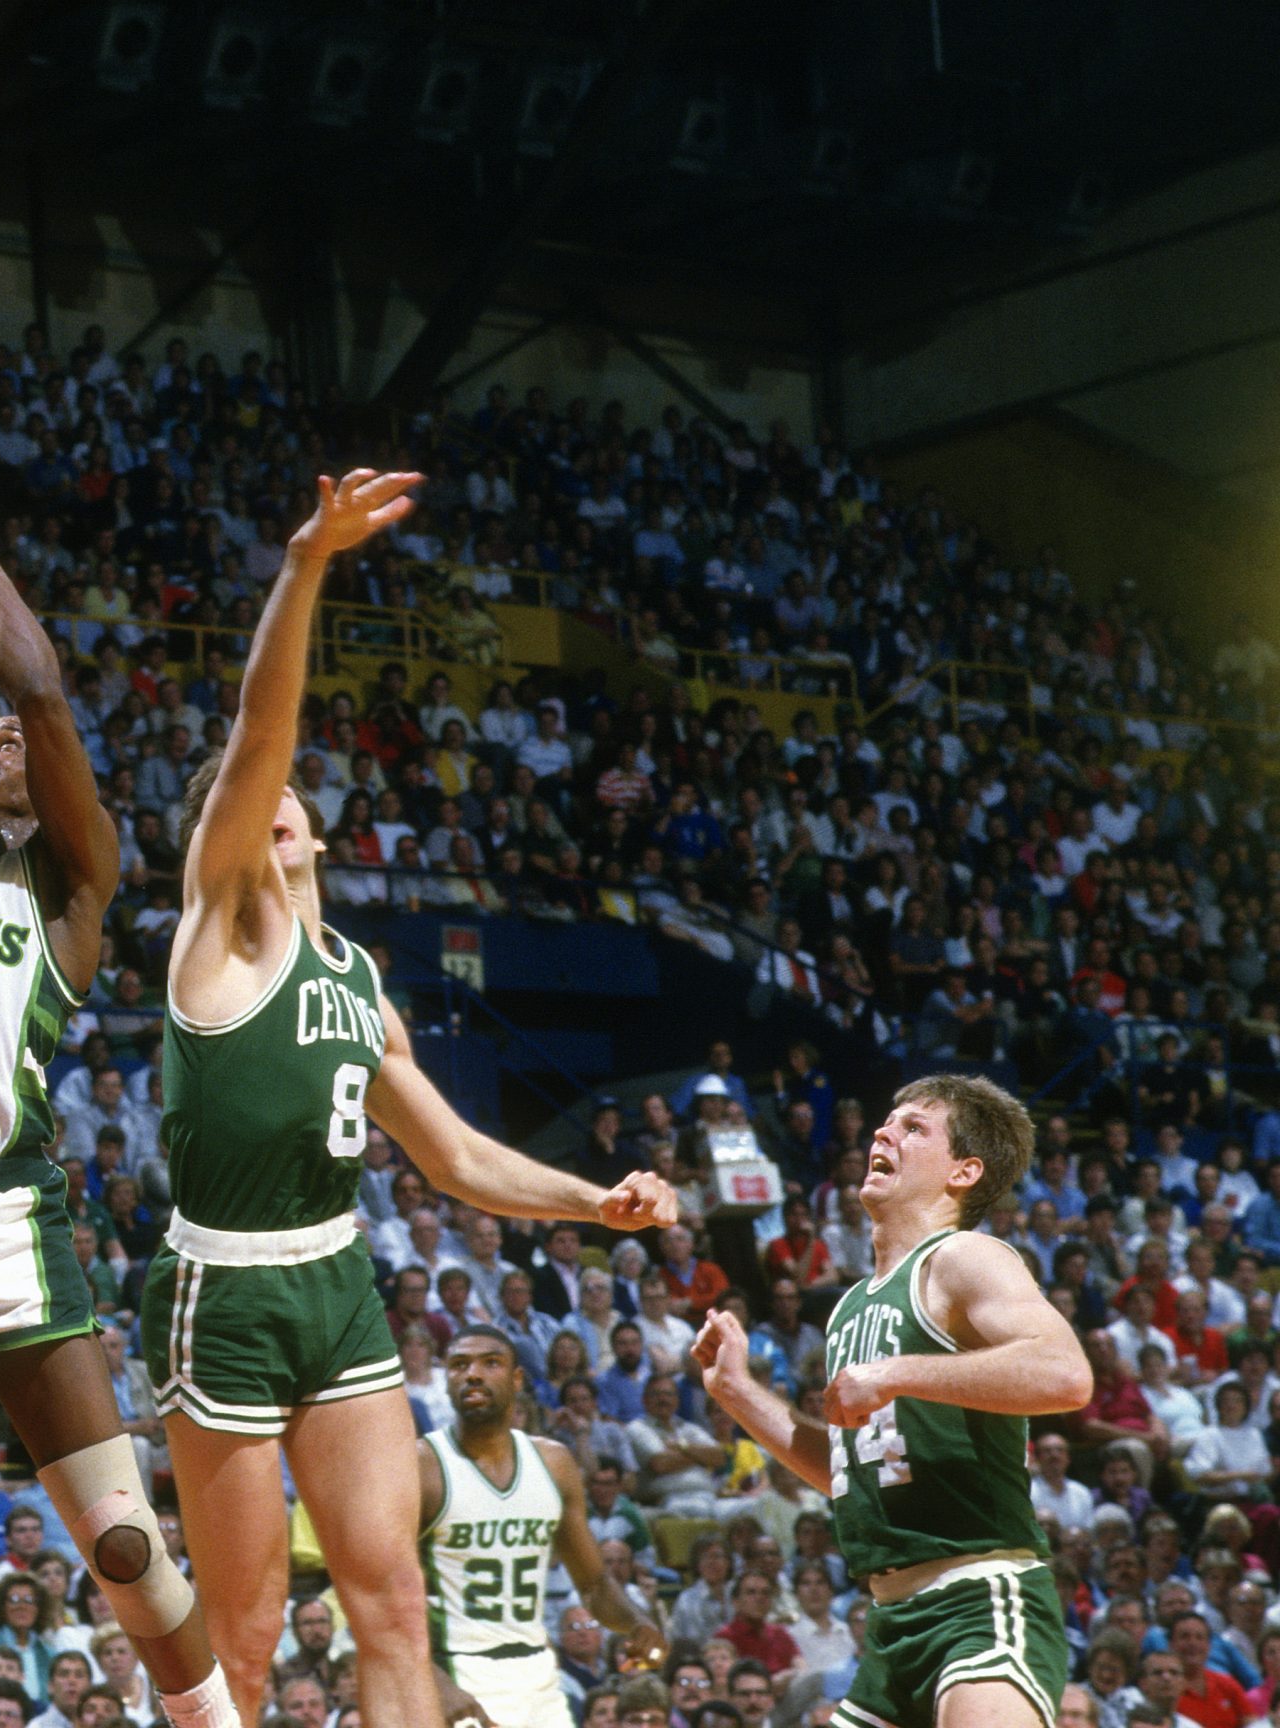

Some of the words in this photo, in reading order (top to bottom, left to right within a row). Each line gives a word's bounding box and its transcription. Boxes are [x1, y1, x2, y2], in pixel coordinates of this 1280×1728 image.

[327, 1063, 368, 1158] 8
[444, 1518, 559, 1549] BUCKS
[463, 1555, 540, 1622] 25
